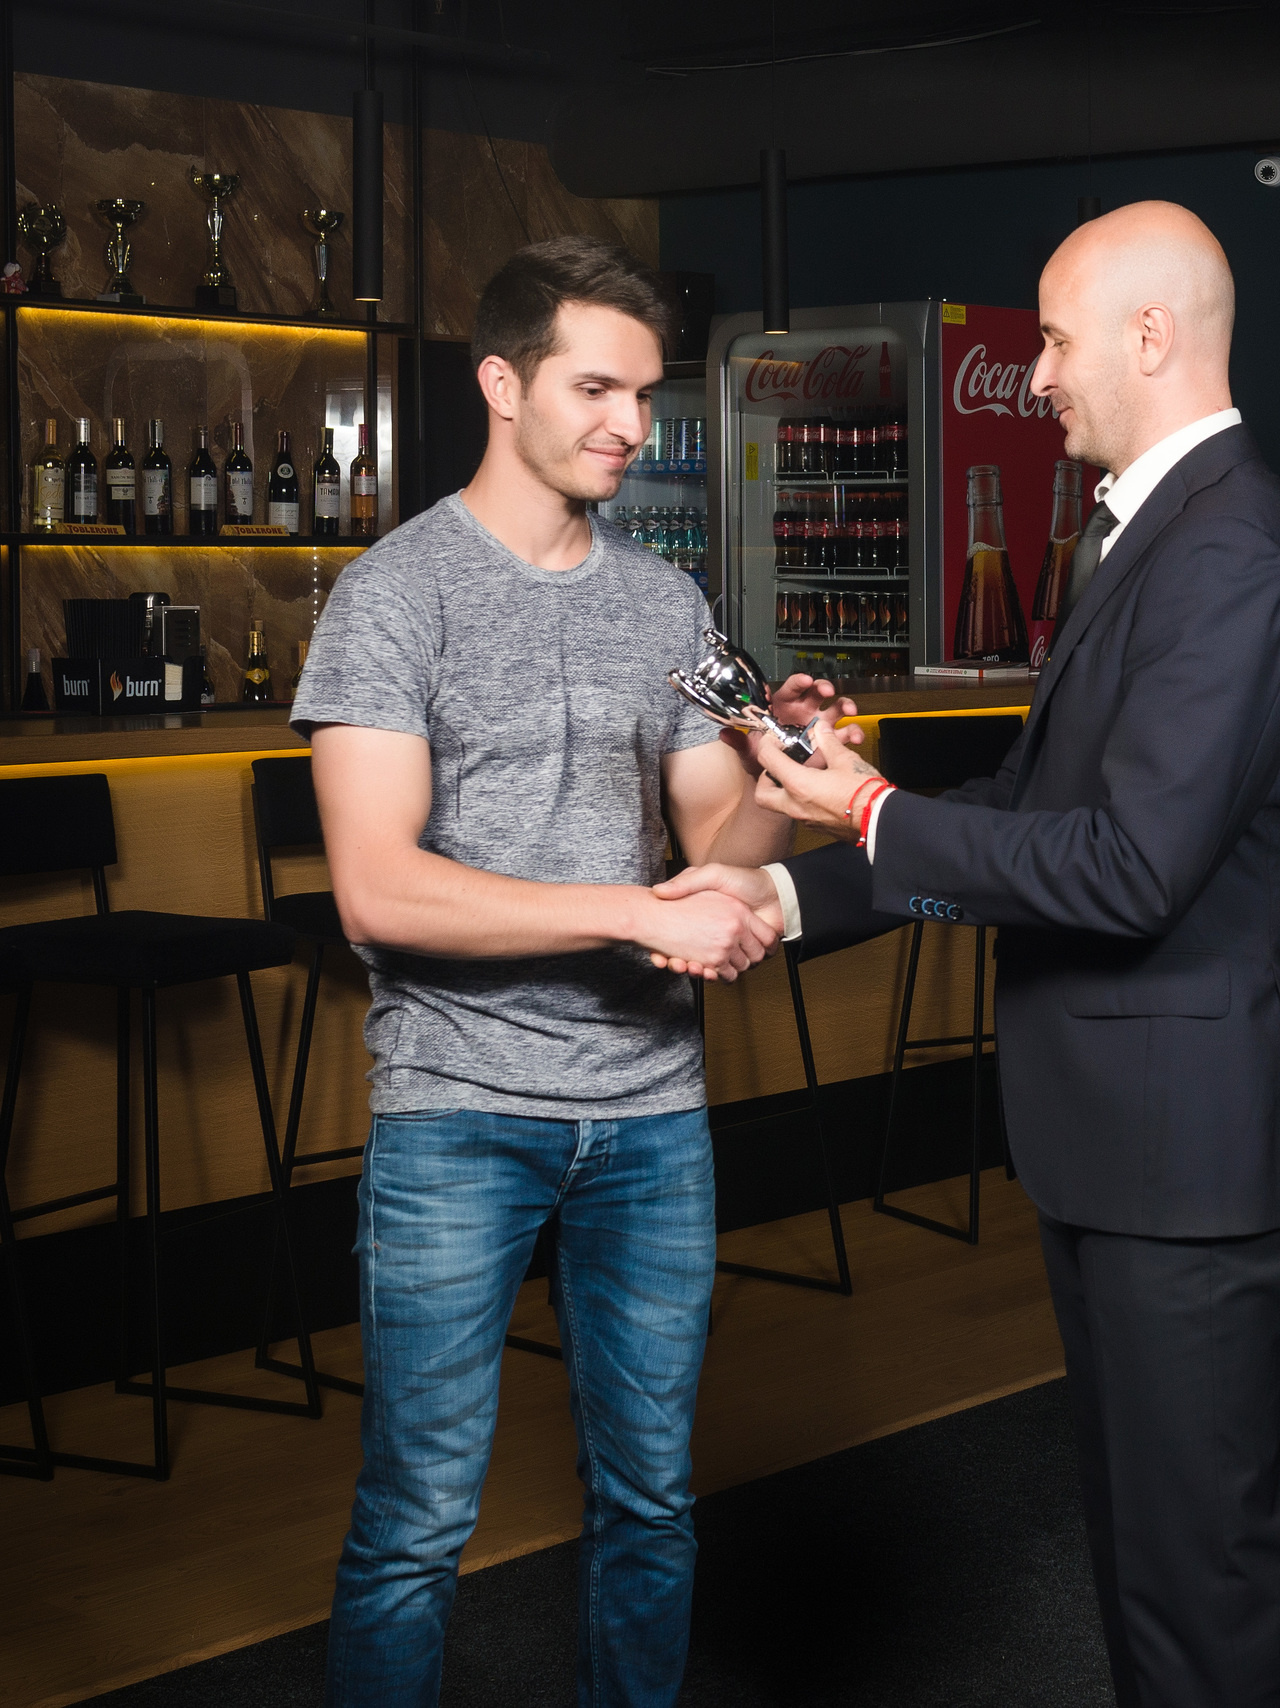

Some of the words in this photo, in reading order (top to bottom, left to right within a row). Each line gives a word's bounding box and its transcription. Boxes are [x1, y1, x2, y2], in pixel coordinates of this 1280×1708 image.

[745, 345, 872, 402] Coca-Cola
[953, 344, 1060, 419] Coca-Co
[67, 525, 118, 534] TOBLERONE
[234, 526, 283, 534] TOBLERONE
[63, 674, 88, 696] burn
[126, 676, 159, 697] burn
